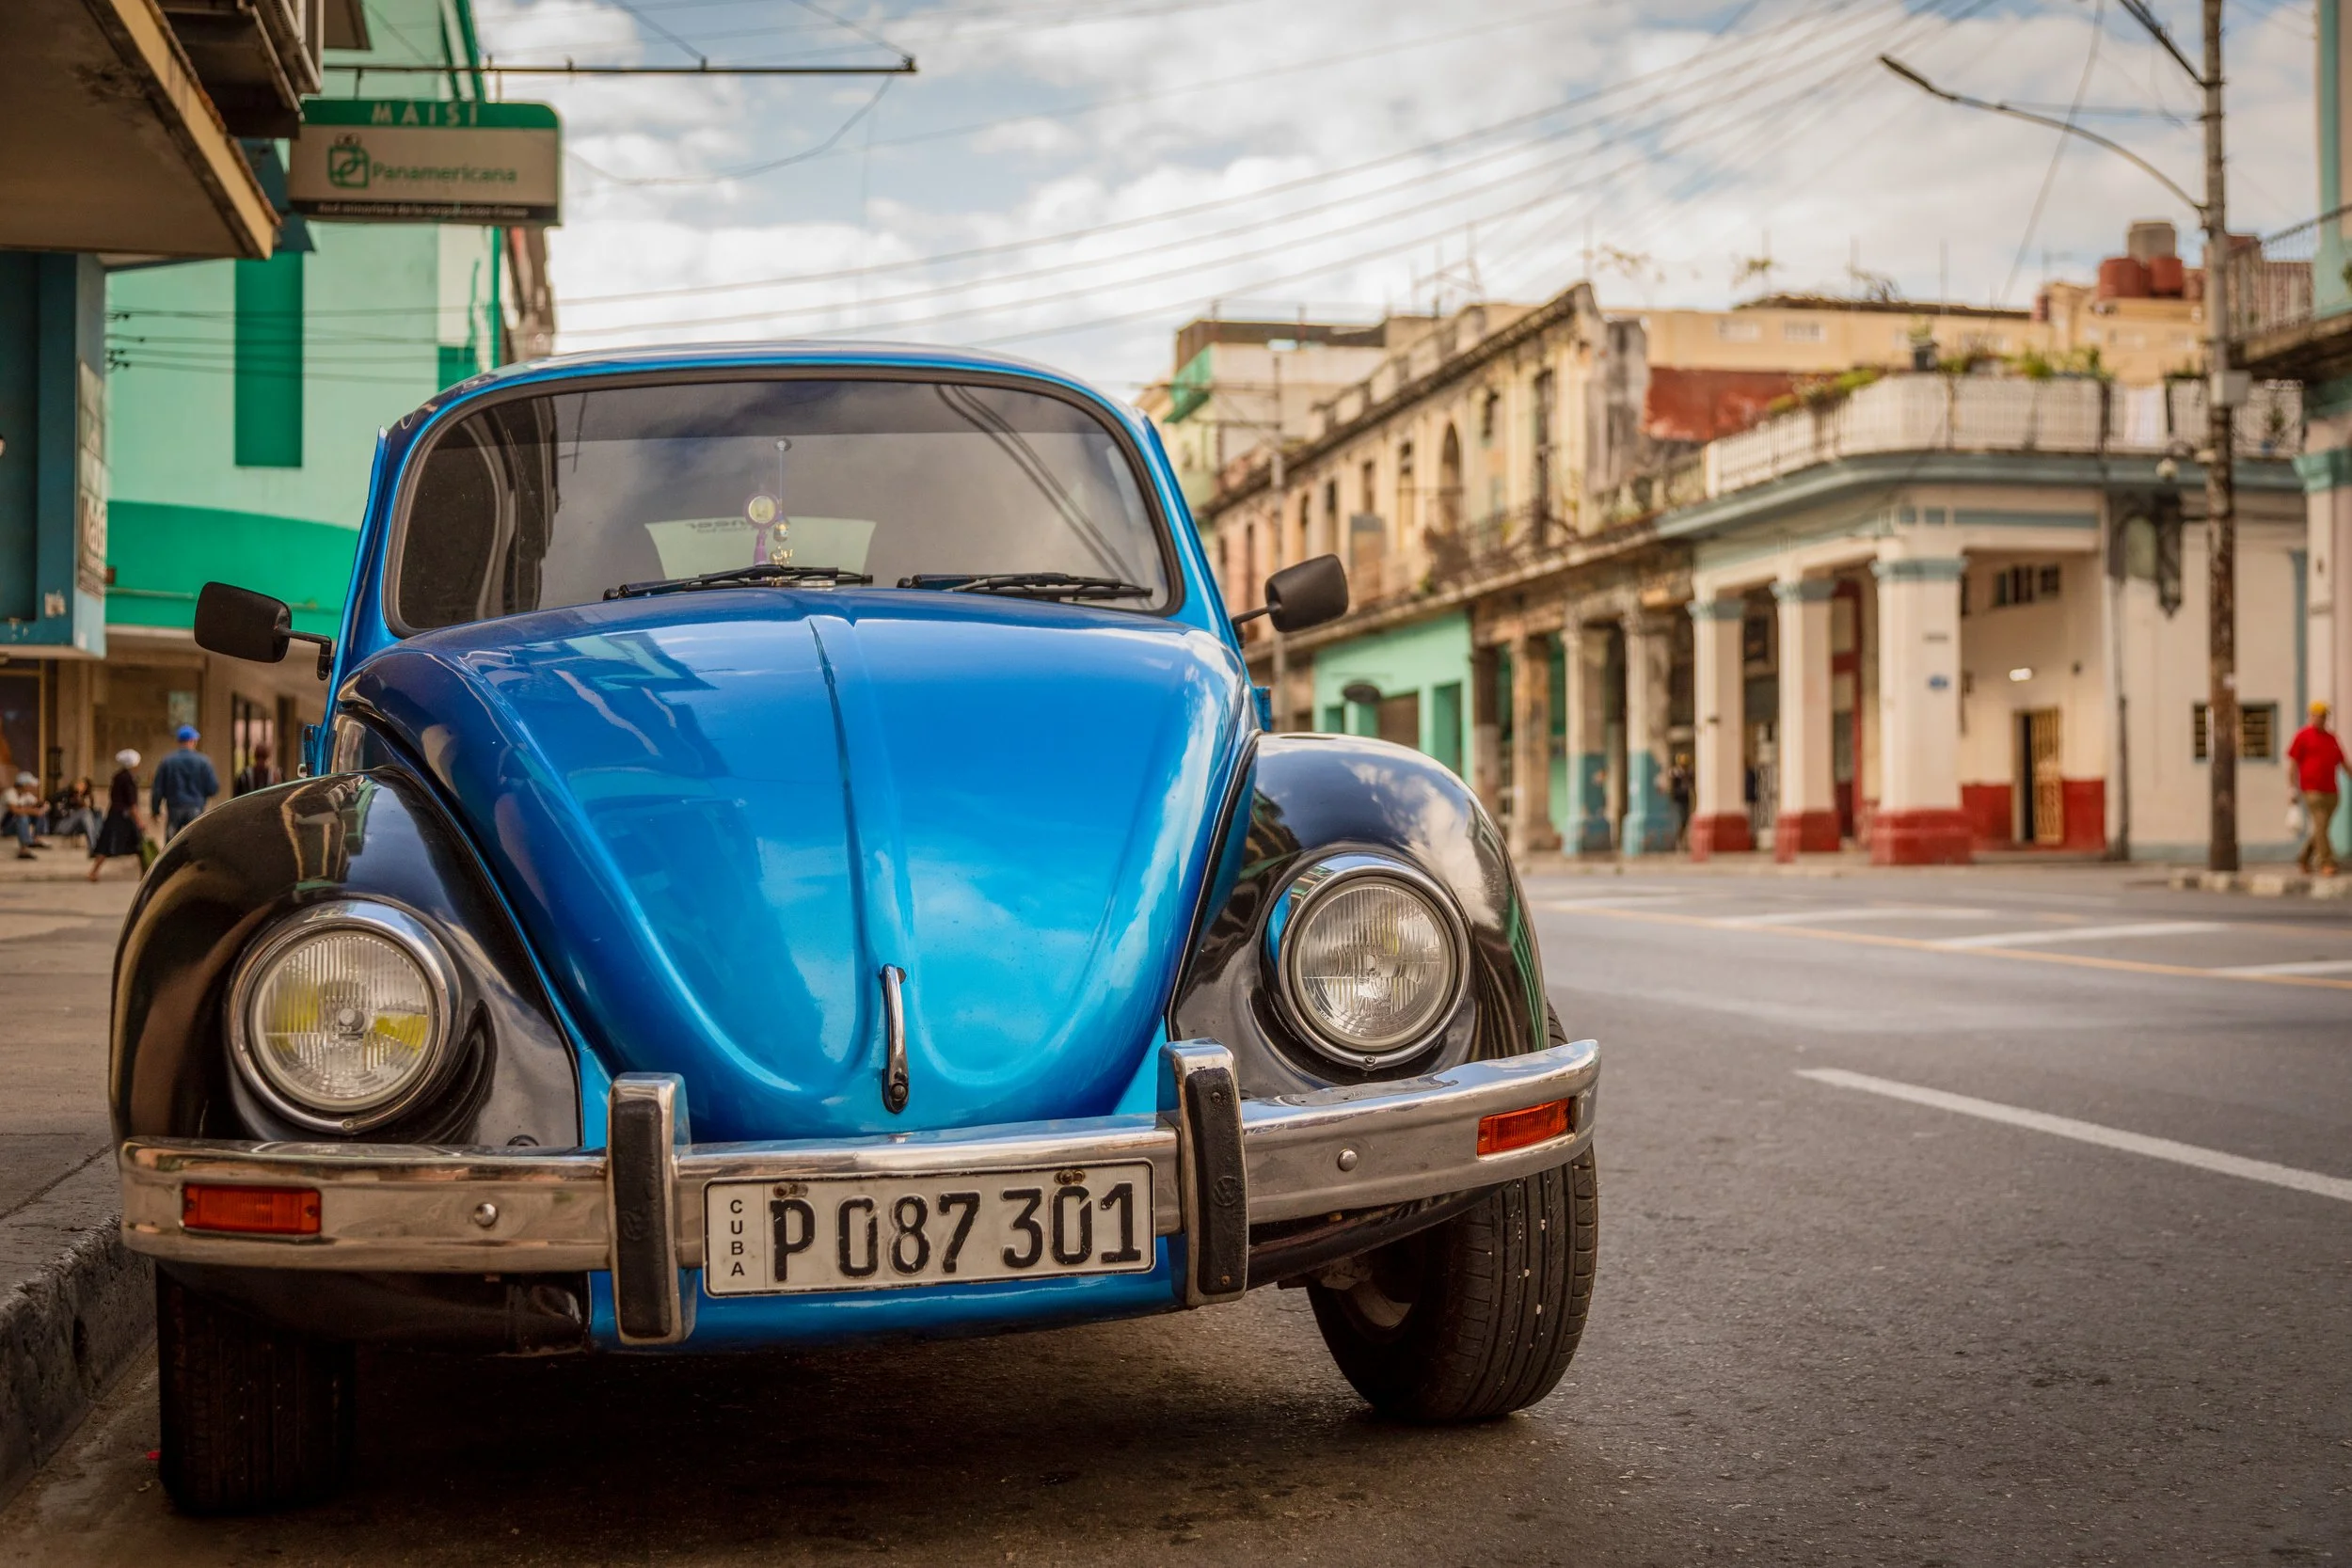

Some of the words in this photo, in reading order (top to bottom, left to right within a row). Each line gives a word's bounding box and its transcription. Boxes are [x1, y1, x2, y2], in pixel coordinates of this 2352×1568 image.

[373, 161, 517, 183] Panamericana
[729, 1198, 745, 1276] CUBA
[770, 1198, 816, 1282] P
[835, 1194, 984, 1278] 087
[999, 1181, 1142, 1269] 301
